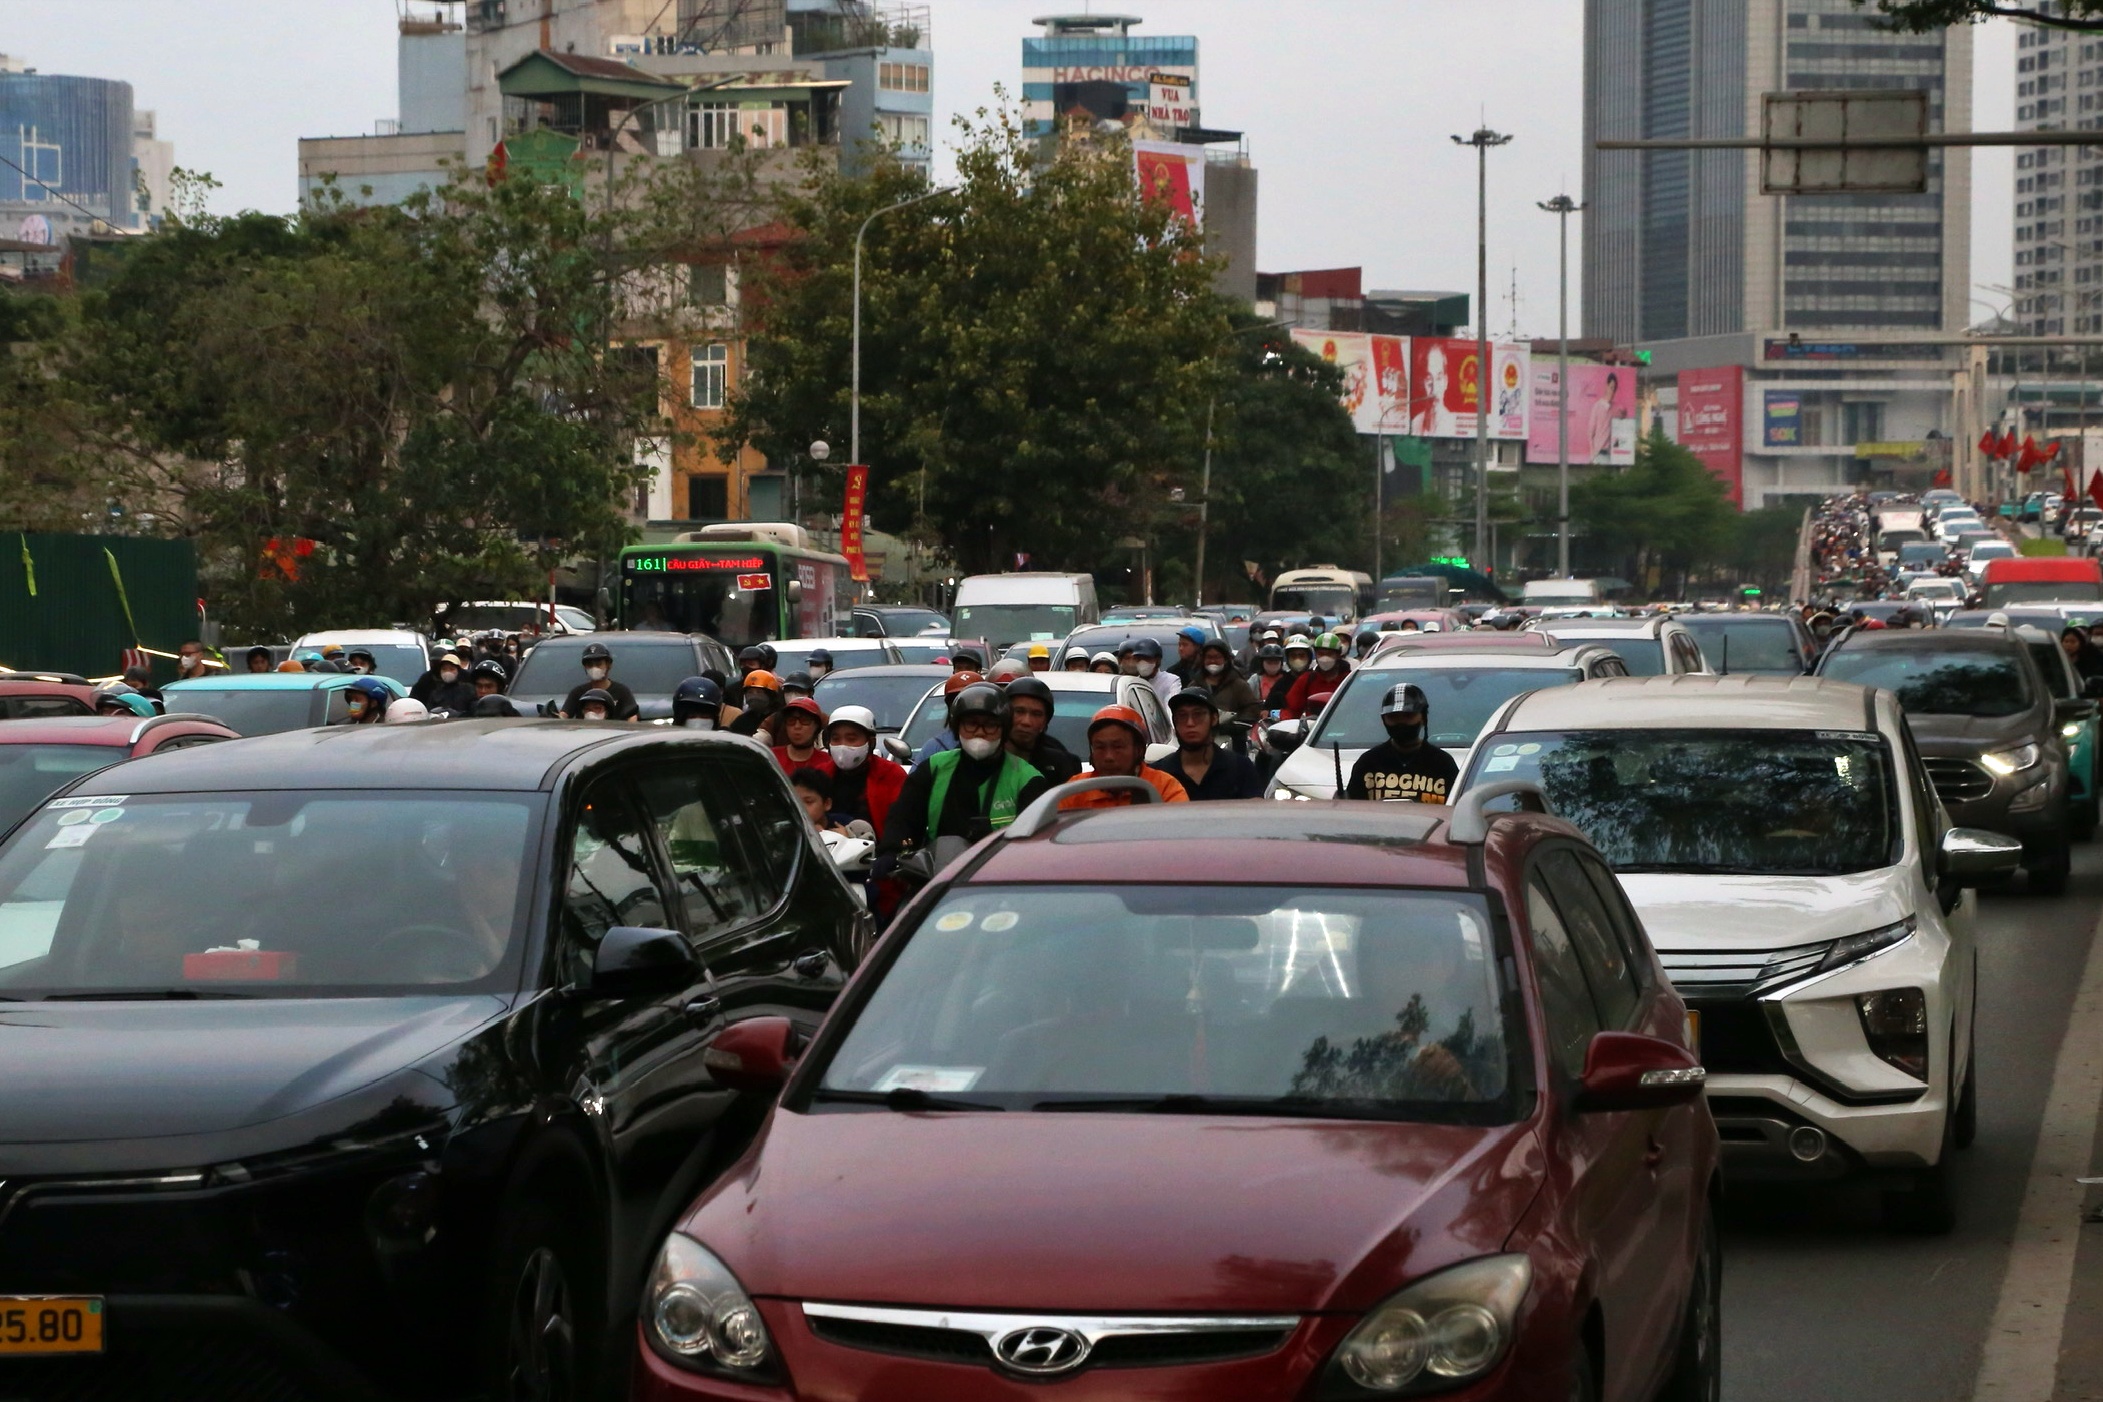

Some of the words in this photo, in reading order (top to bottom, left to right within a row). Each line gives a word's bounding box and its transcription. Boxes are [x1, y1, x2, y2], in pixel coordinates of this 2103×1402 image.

[1161, 87, 1180, 102] VUA
[1151, 104, 1170, 120] NHÀ
[636, 559, 661, 570] 161
[0, 1309, 82, 1342] 5.80
